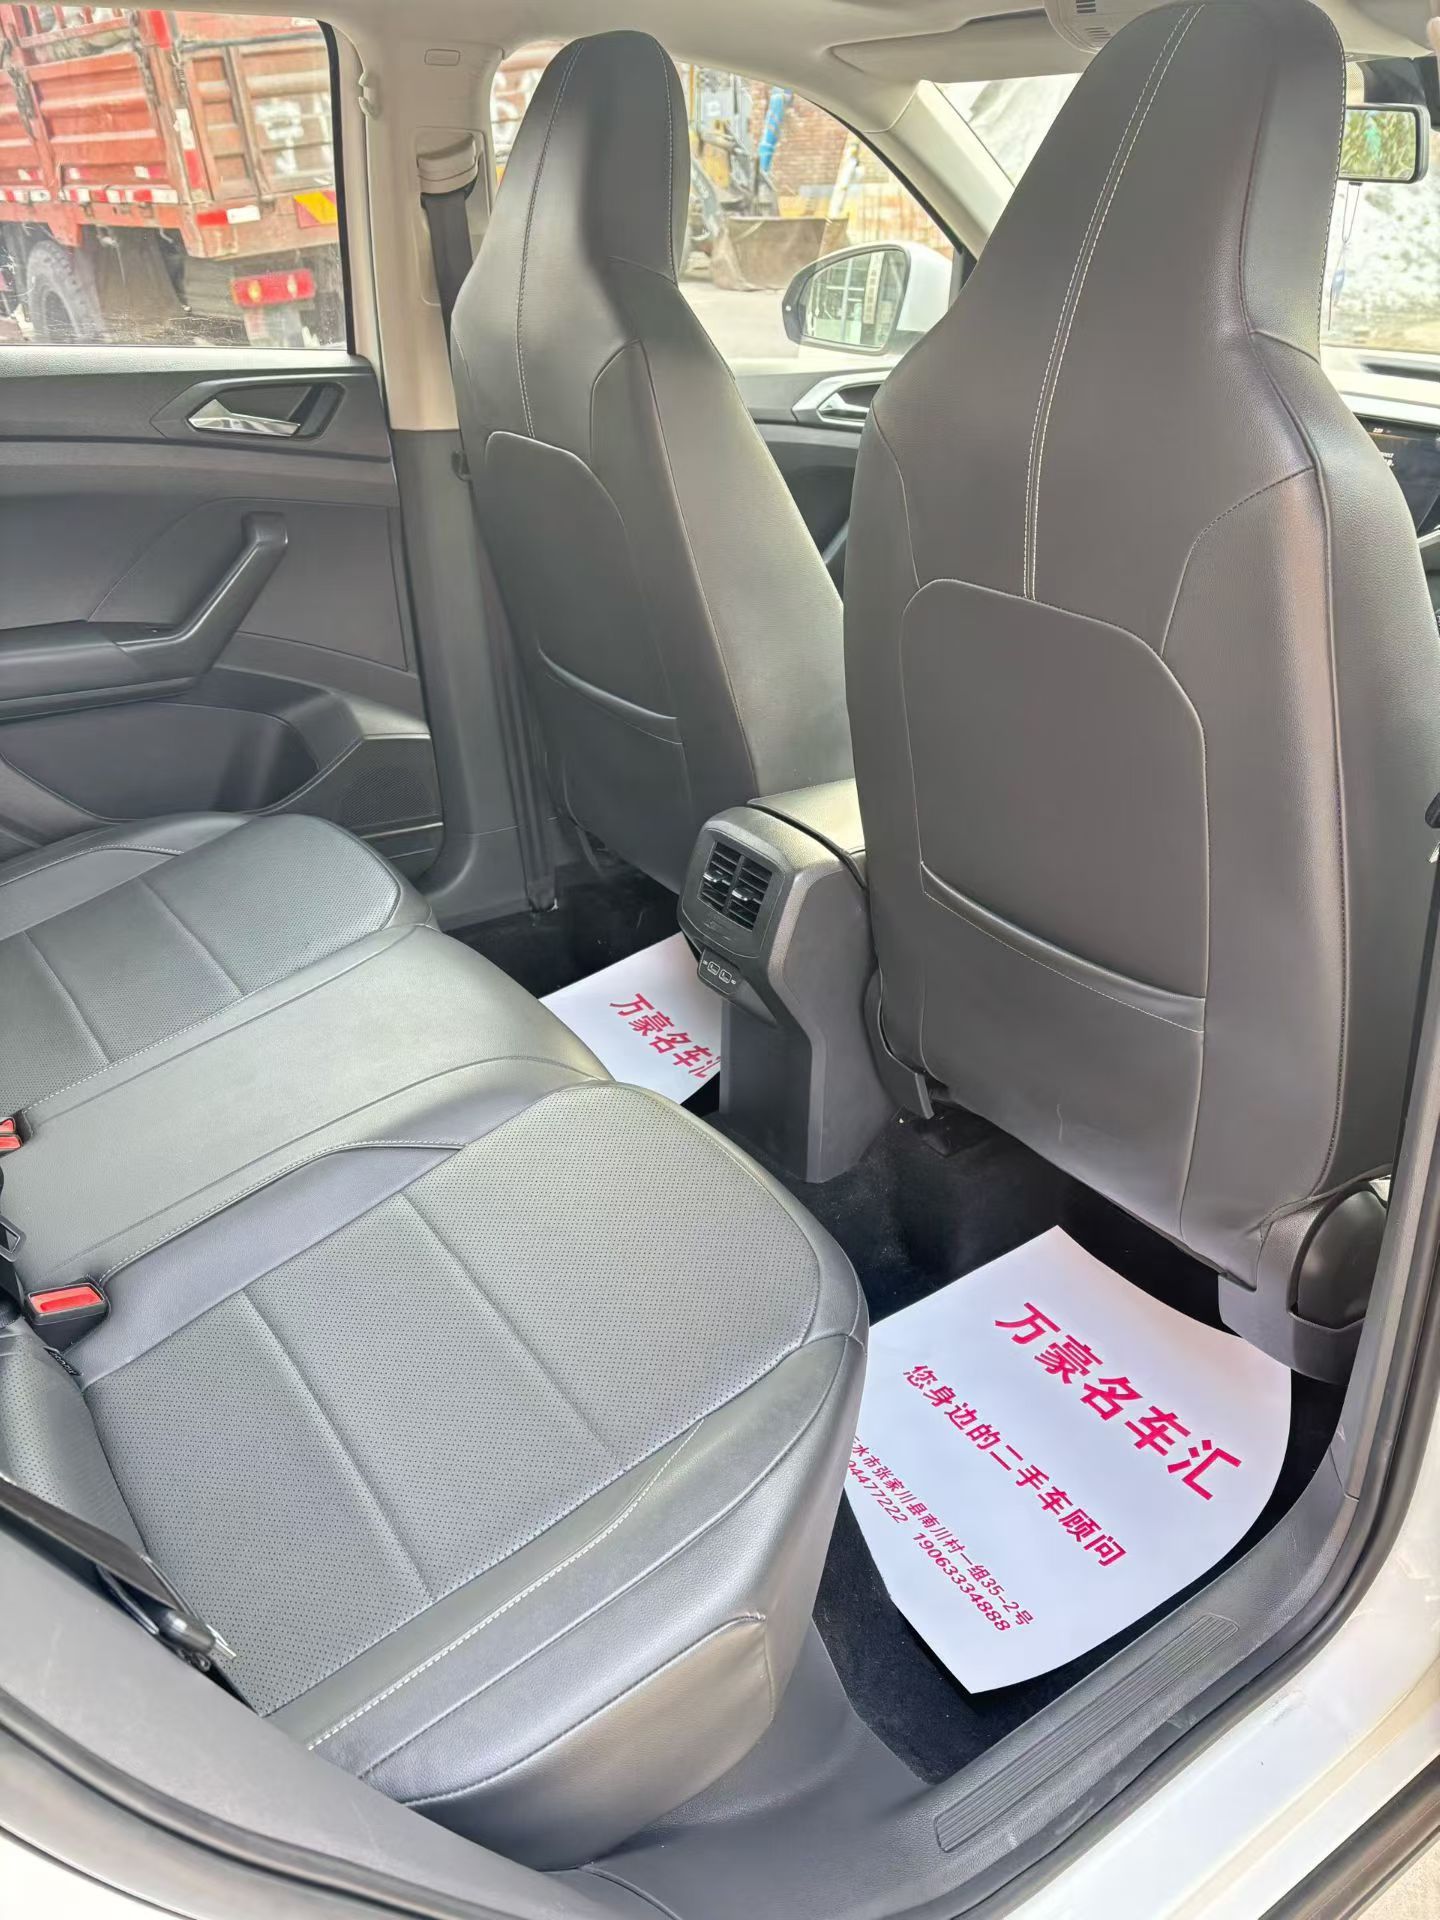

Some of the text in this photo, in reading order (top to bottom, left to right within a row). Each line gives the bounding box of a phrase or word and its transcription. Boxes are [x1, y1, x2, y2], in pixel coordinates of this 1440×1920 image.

[903, 1364, 1127, 1567] 您身边的二手车顾问
[994, 1302, 1242, 1501] 万豪名车汇
[853, 1435, 1034, 1625] 水市张家川县南川村一组35-2号
[912, 1532, 1011, 1631] 19063334888
